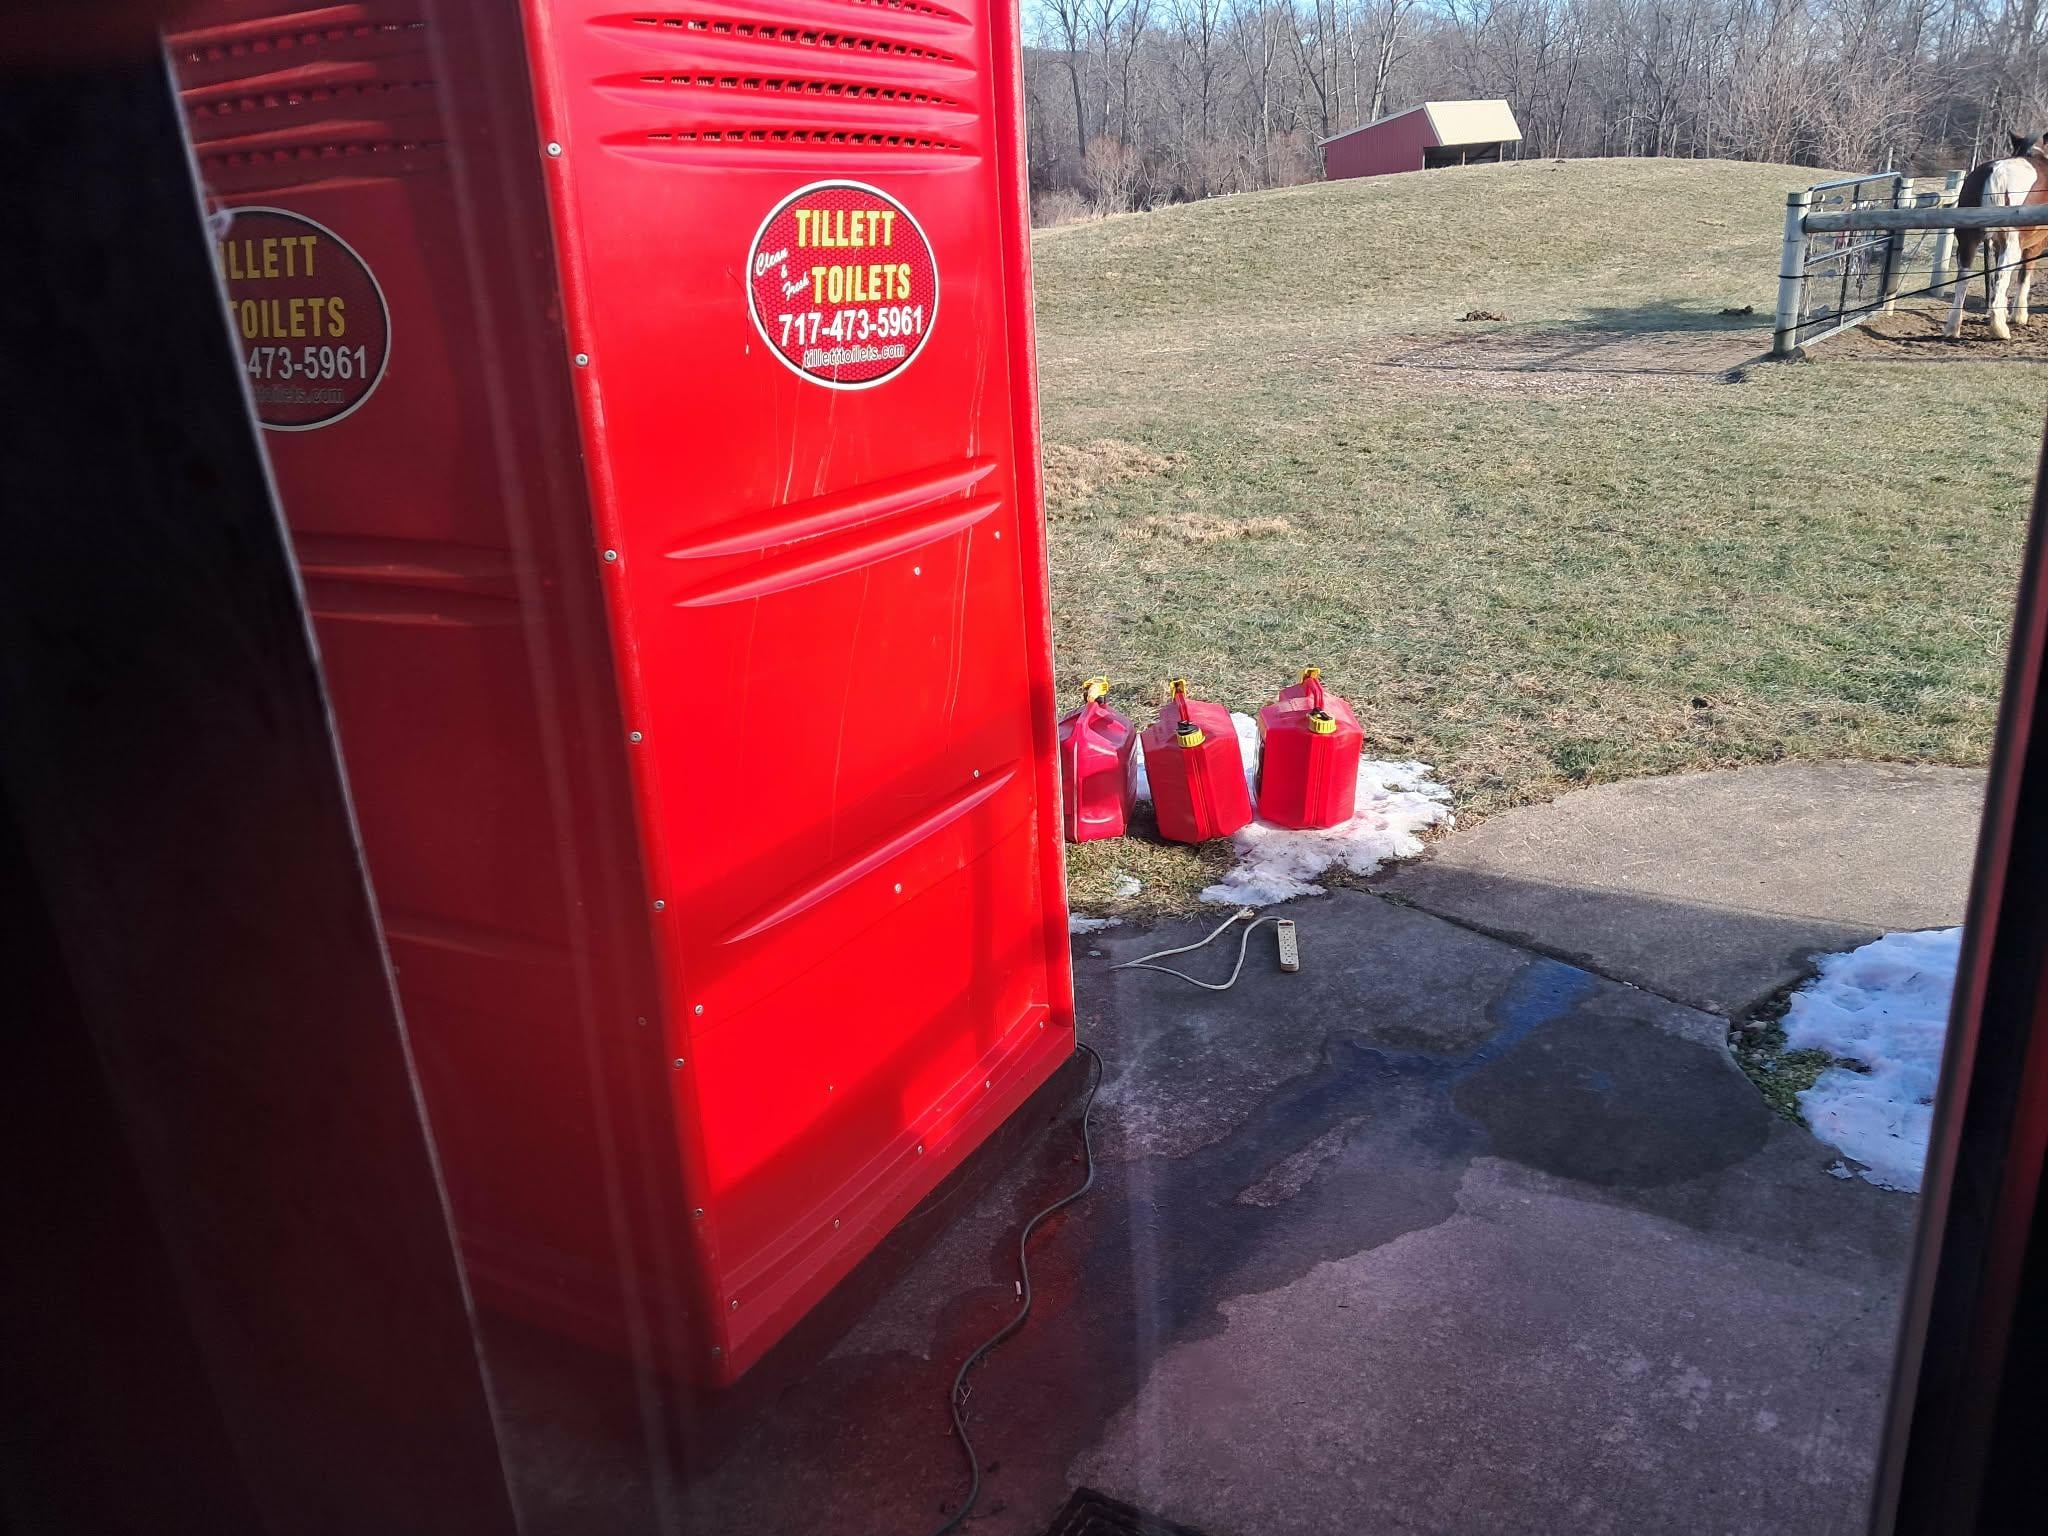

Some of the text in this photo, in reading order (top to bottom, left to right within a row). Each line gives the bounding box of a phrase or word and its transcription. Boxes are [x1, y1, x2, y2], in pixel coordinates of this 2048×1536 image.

[795, 209, 895, 247] TILLETT
[219, 236, 317, 278] ILLETT
[756, 248, 788, 276] Clean
[811, 262, 911, 304] TOILETS
[779, 305, 921, 347] 717-473-5961
[248, 345, 367, 379] 473-5961
[804, 344, 905, 368] tilletttoilets.com
